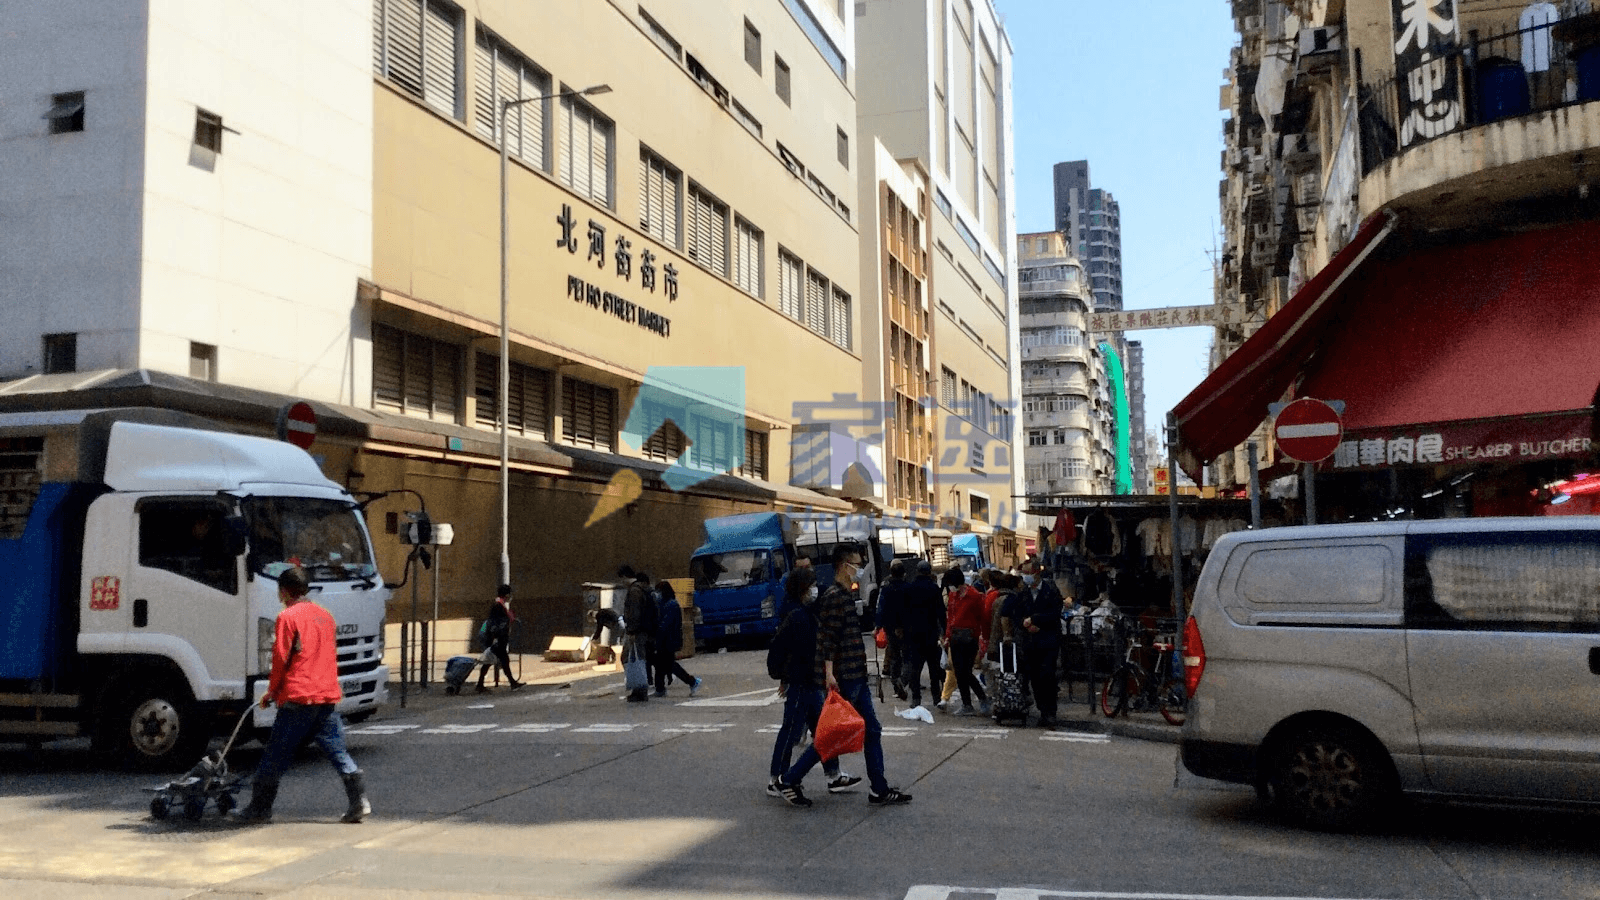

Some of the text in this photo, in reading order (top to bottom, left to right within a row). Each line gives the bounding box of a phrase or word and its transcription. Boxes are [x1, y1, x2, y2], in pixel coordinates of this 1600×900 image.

[556, 203, 679, 303] 北河街街市
[567, 274, 672, 339] PEI HO STREET MARKET
[1519, 437, 1592, 457] BUTCHER
